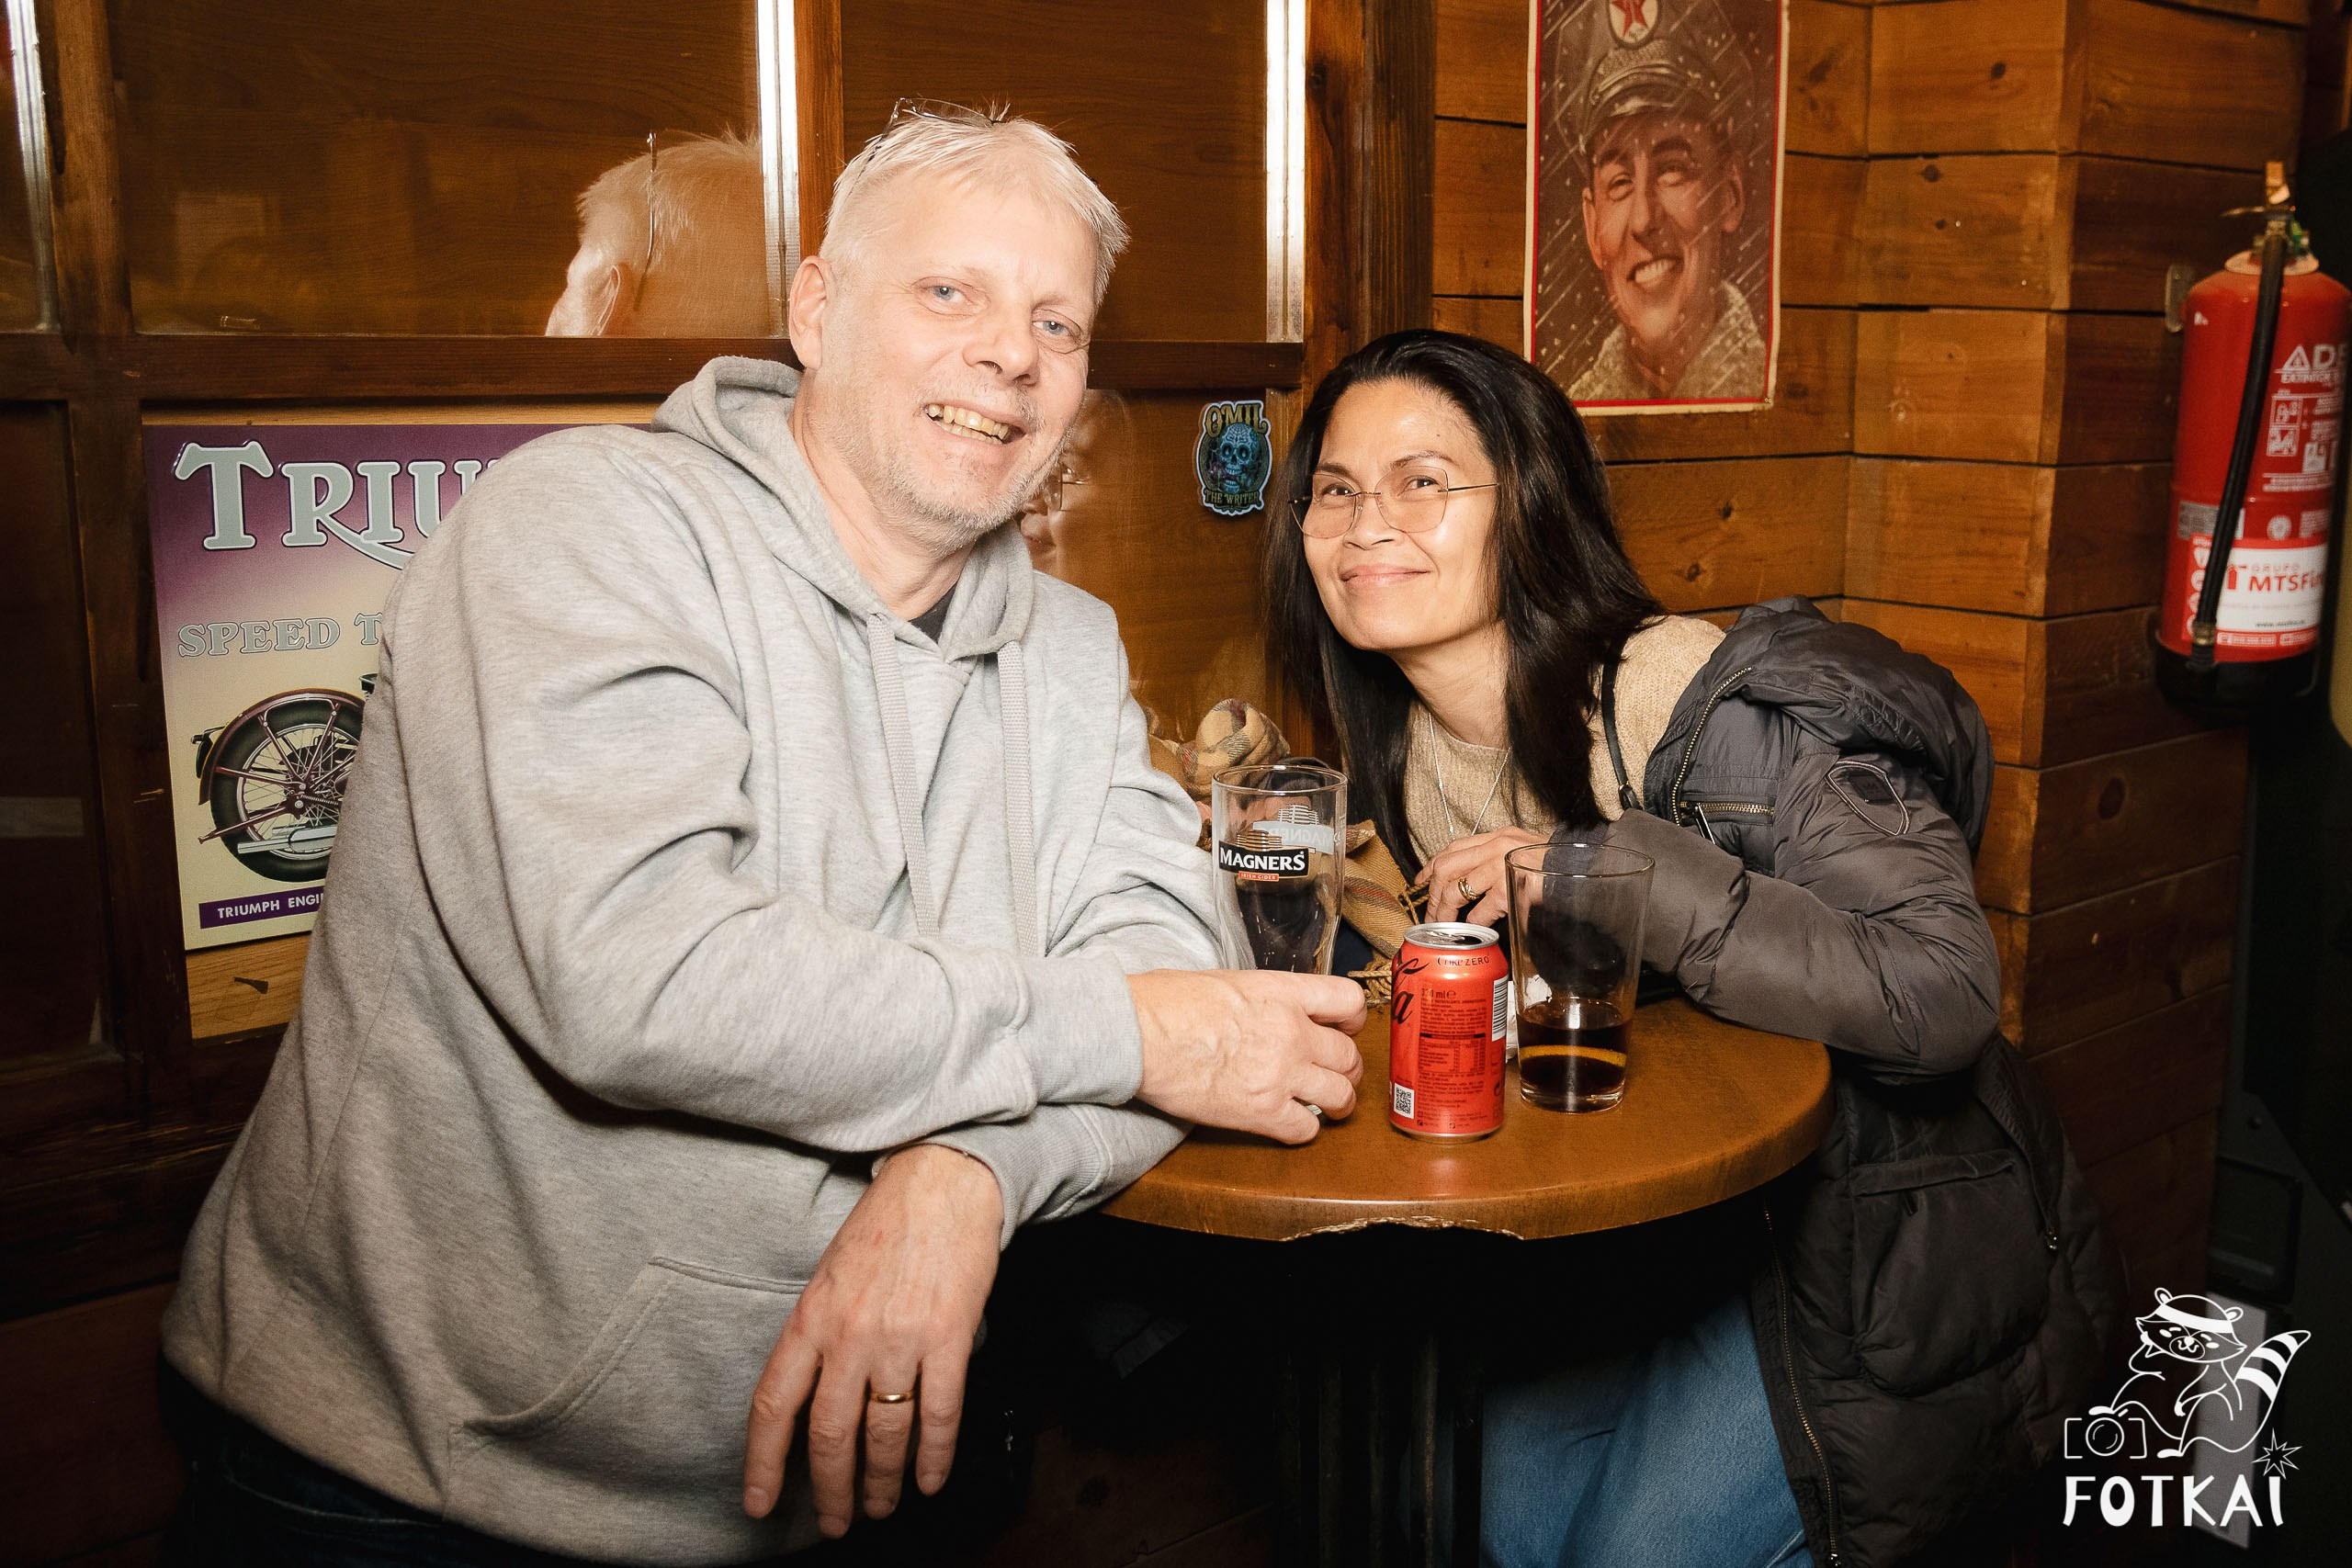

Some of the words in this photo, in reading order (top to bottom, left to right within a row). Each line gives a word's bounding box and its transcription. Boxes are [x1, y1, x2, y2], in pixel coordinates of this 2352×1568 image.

[1205, 404, 1269, 437] OMIL
[174, 440, 501, 570] TRIU
[1204, 491, 1223, 503] THE
[1225, 491, 1262, 505] WRITER
[178, 618, 341, 658] SPEED
[1219, 847, 1306, 872] MAGNERS
[217, 899, 280, 919] TRIUMPH
[1464, 955, 1490, 966] ZERO
